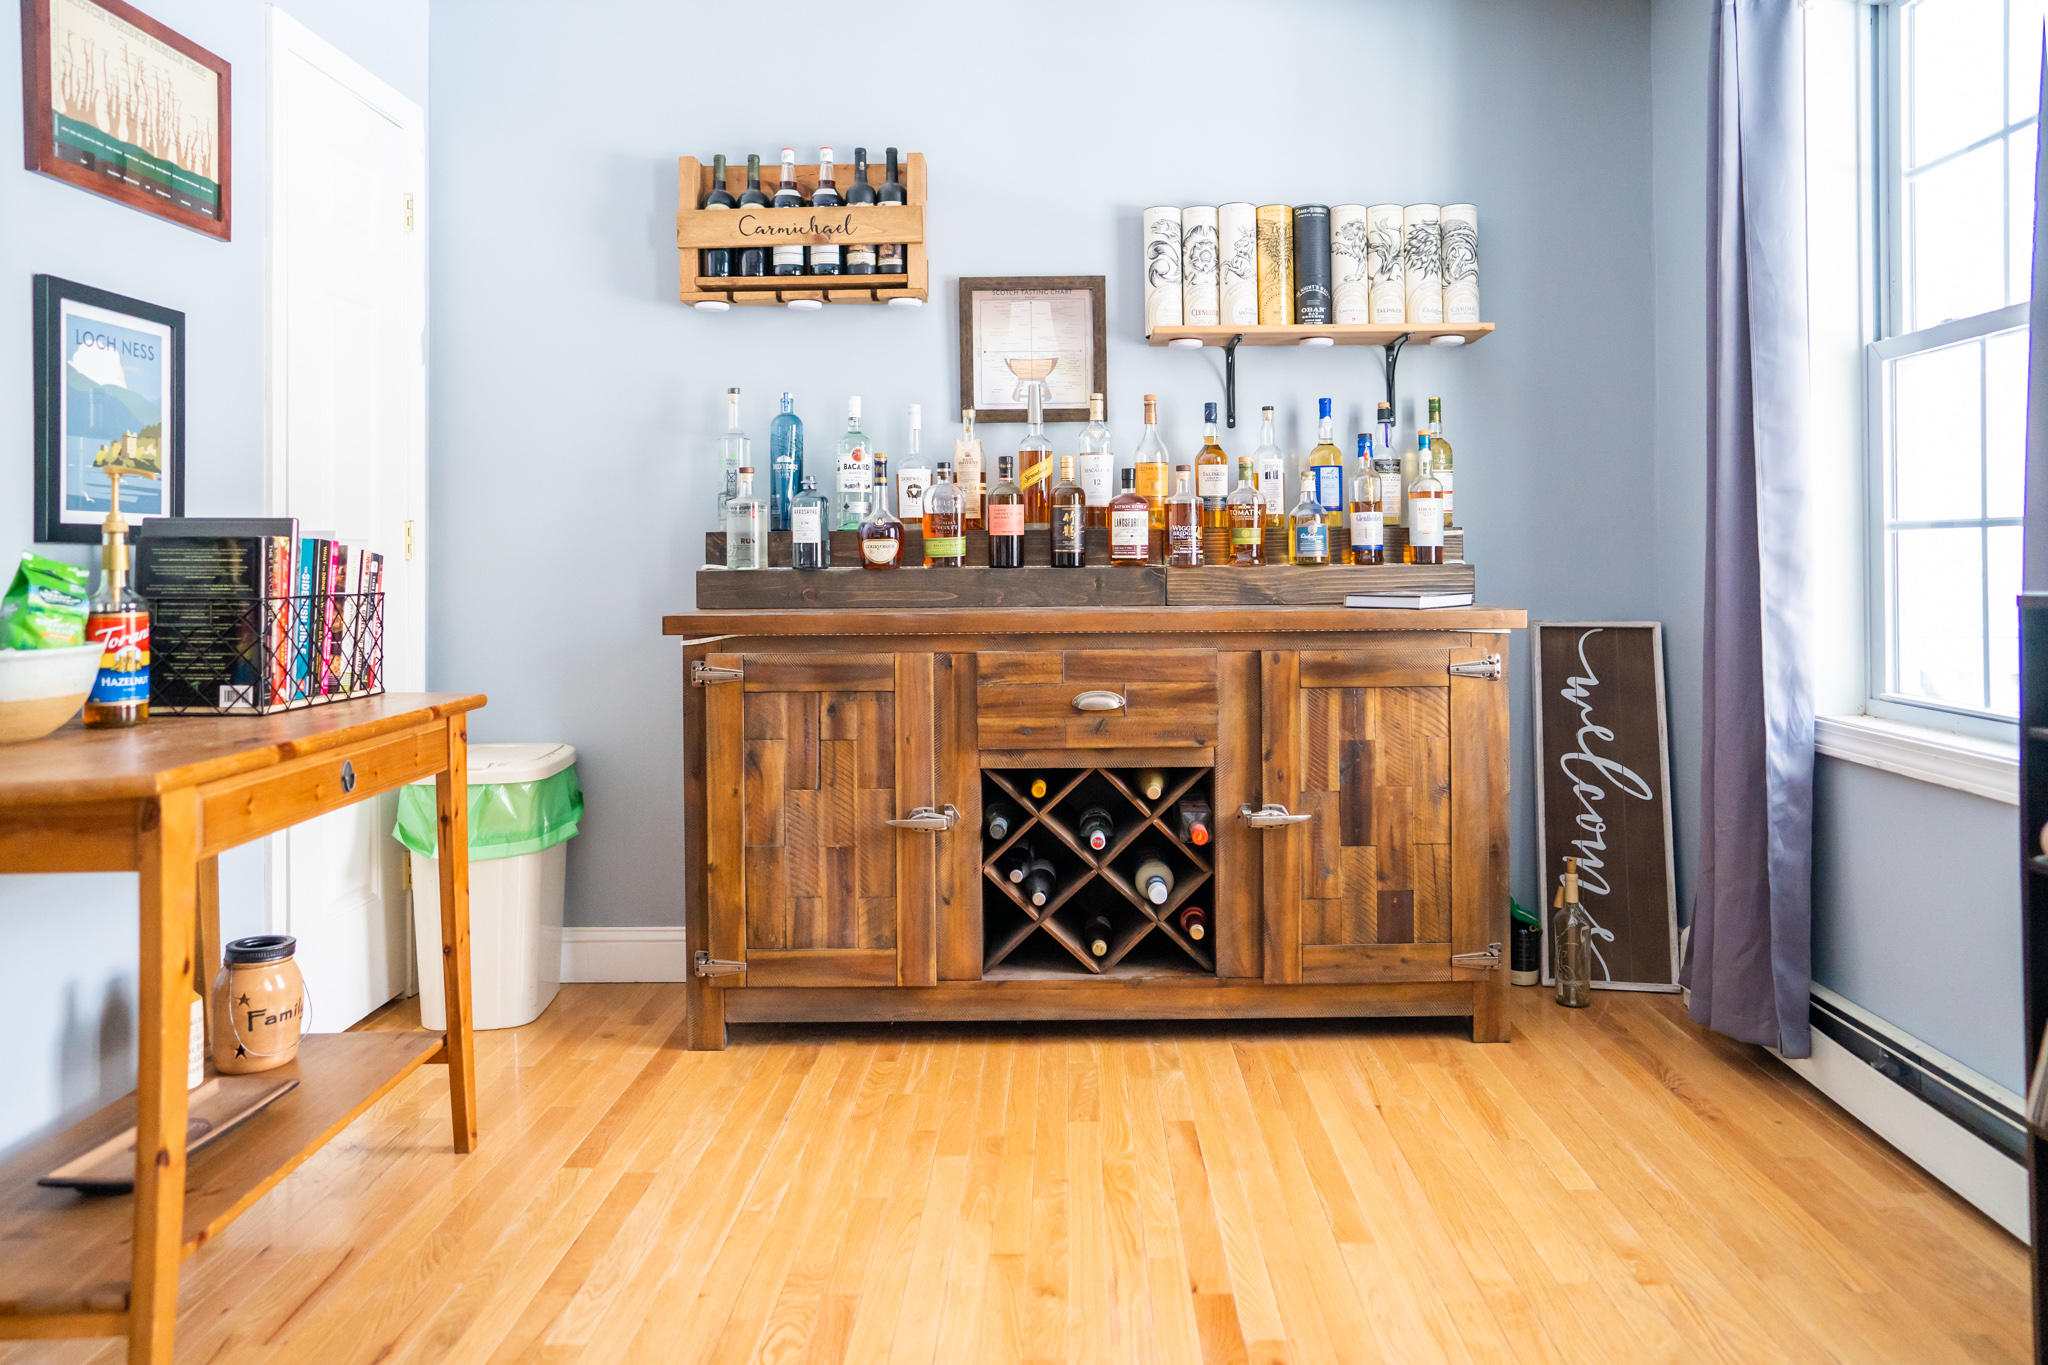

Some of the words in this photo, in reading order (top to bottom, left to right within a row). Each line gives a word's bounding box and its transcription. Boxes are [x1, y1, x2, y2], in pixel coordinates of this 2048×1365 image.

[738, 213, 859, 238] Carmichael
[992, 288, 1019, 296] SCOTCH
[75, 328, 117, 352] LOCH
[122, 338, 155, 361] NESS
[302, 573, 310, 596] SIDE
[300, 599, 309, 623] DISH
[95, 622, 149, 650] Torani
[299, 624, 309, 655] BIBLE
[101, 675, 149, 688] HAZELNUT
[1560, 627, 1653, 983] welcome
